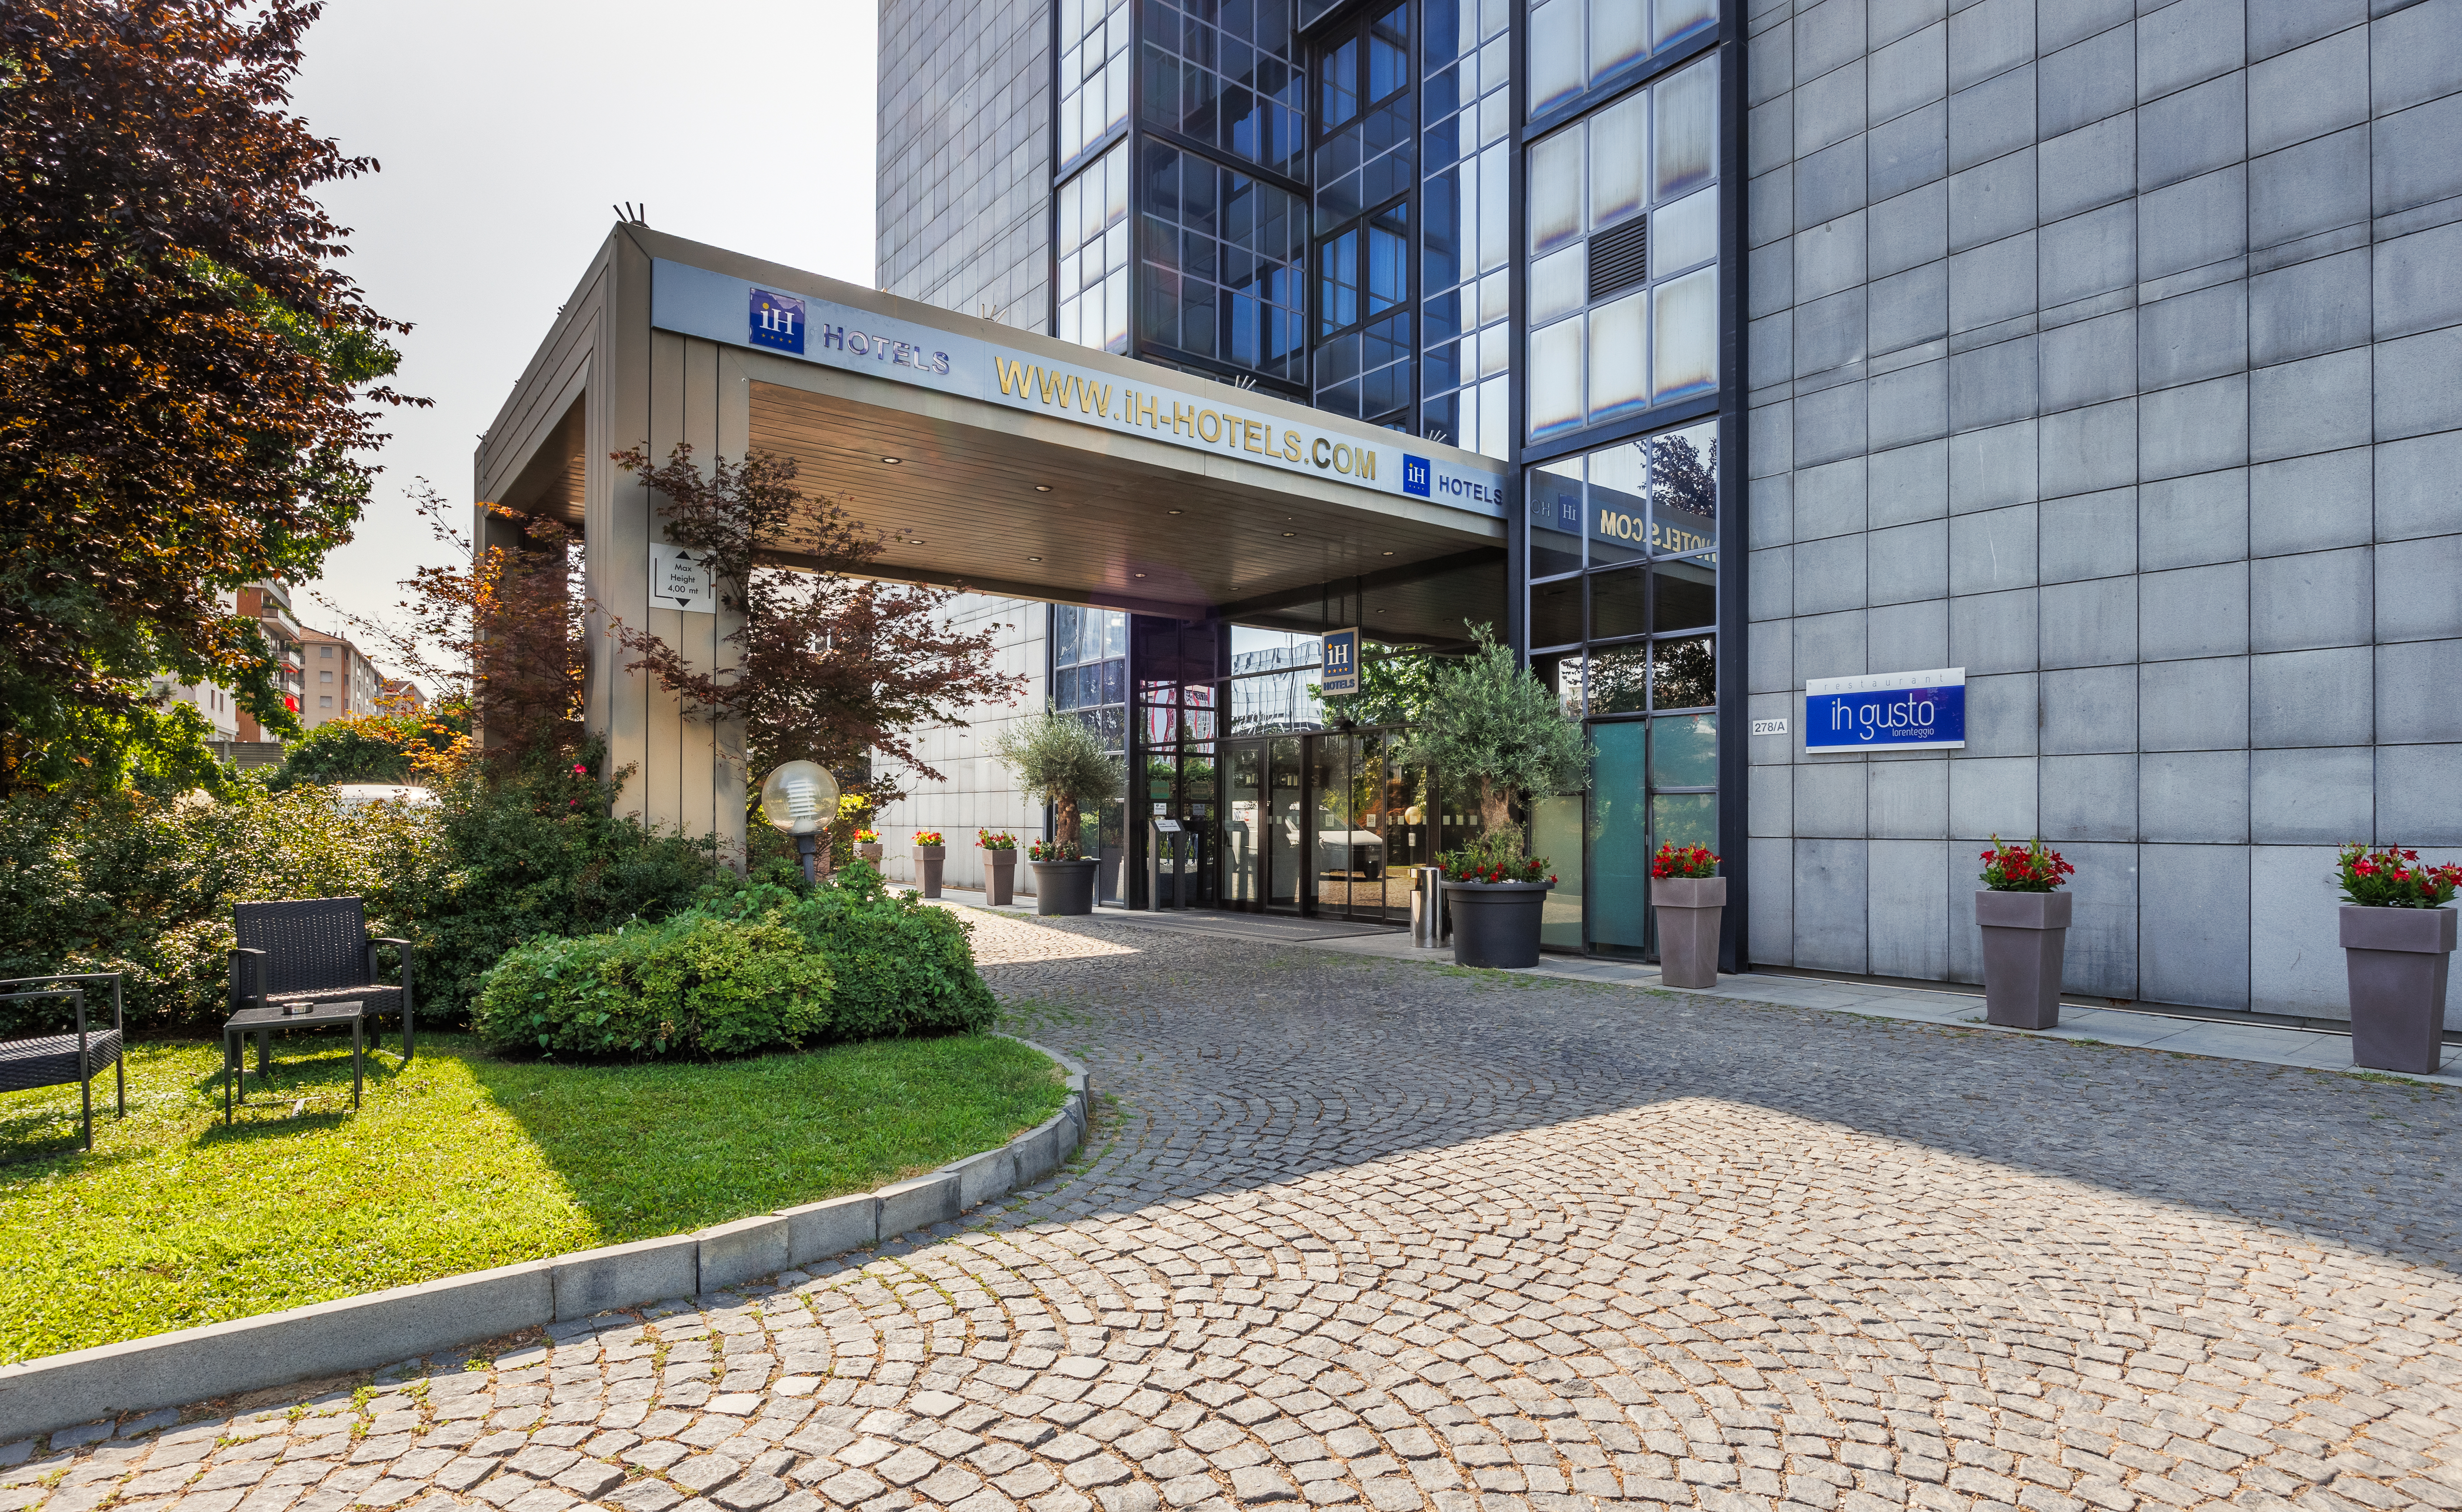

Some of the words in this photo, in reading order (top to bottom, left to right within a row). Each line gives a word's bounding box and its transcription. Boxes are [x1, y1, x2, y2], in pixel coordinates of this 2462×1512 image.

[759, 303, 795, 335] iH
[824, 323, 949, 375] HOTELS
[995, 356, 1375, 480] WWW.iH-HOTELS.COM
[1408, 463, 1425, 485] iH
[1439, 475, 1503, 506] HOTELS
[674, 564, 692, 572] Max
[670, 574, 696, 584] Height
[667, 584, 686, 593] 4,00
[1327, 643, 1348, 666] iH
[1323, 678, 1355, 691] HOTELS
[1824, 673, 1943, 691] restaurant
[1832, 698, 1852, 730] ih
[1860, 693, 1934, 740] gusto
[1754, 721, 1785, 732] 278/A
[1892, 727, 1934, 738] lorenteggio
